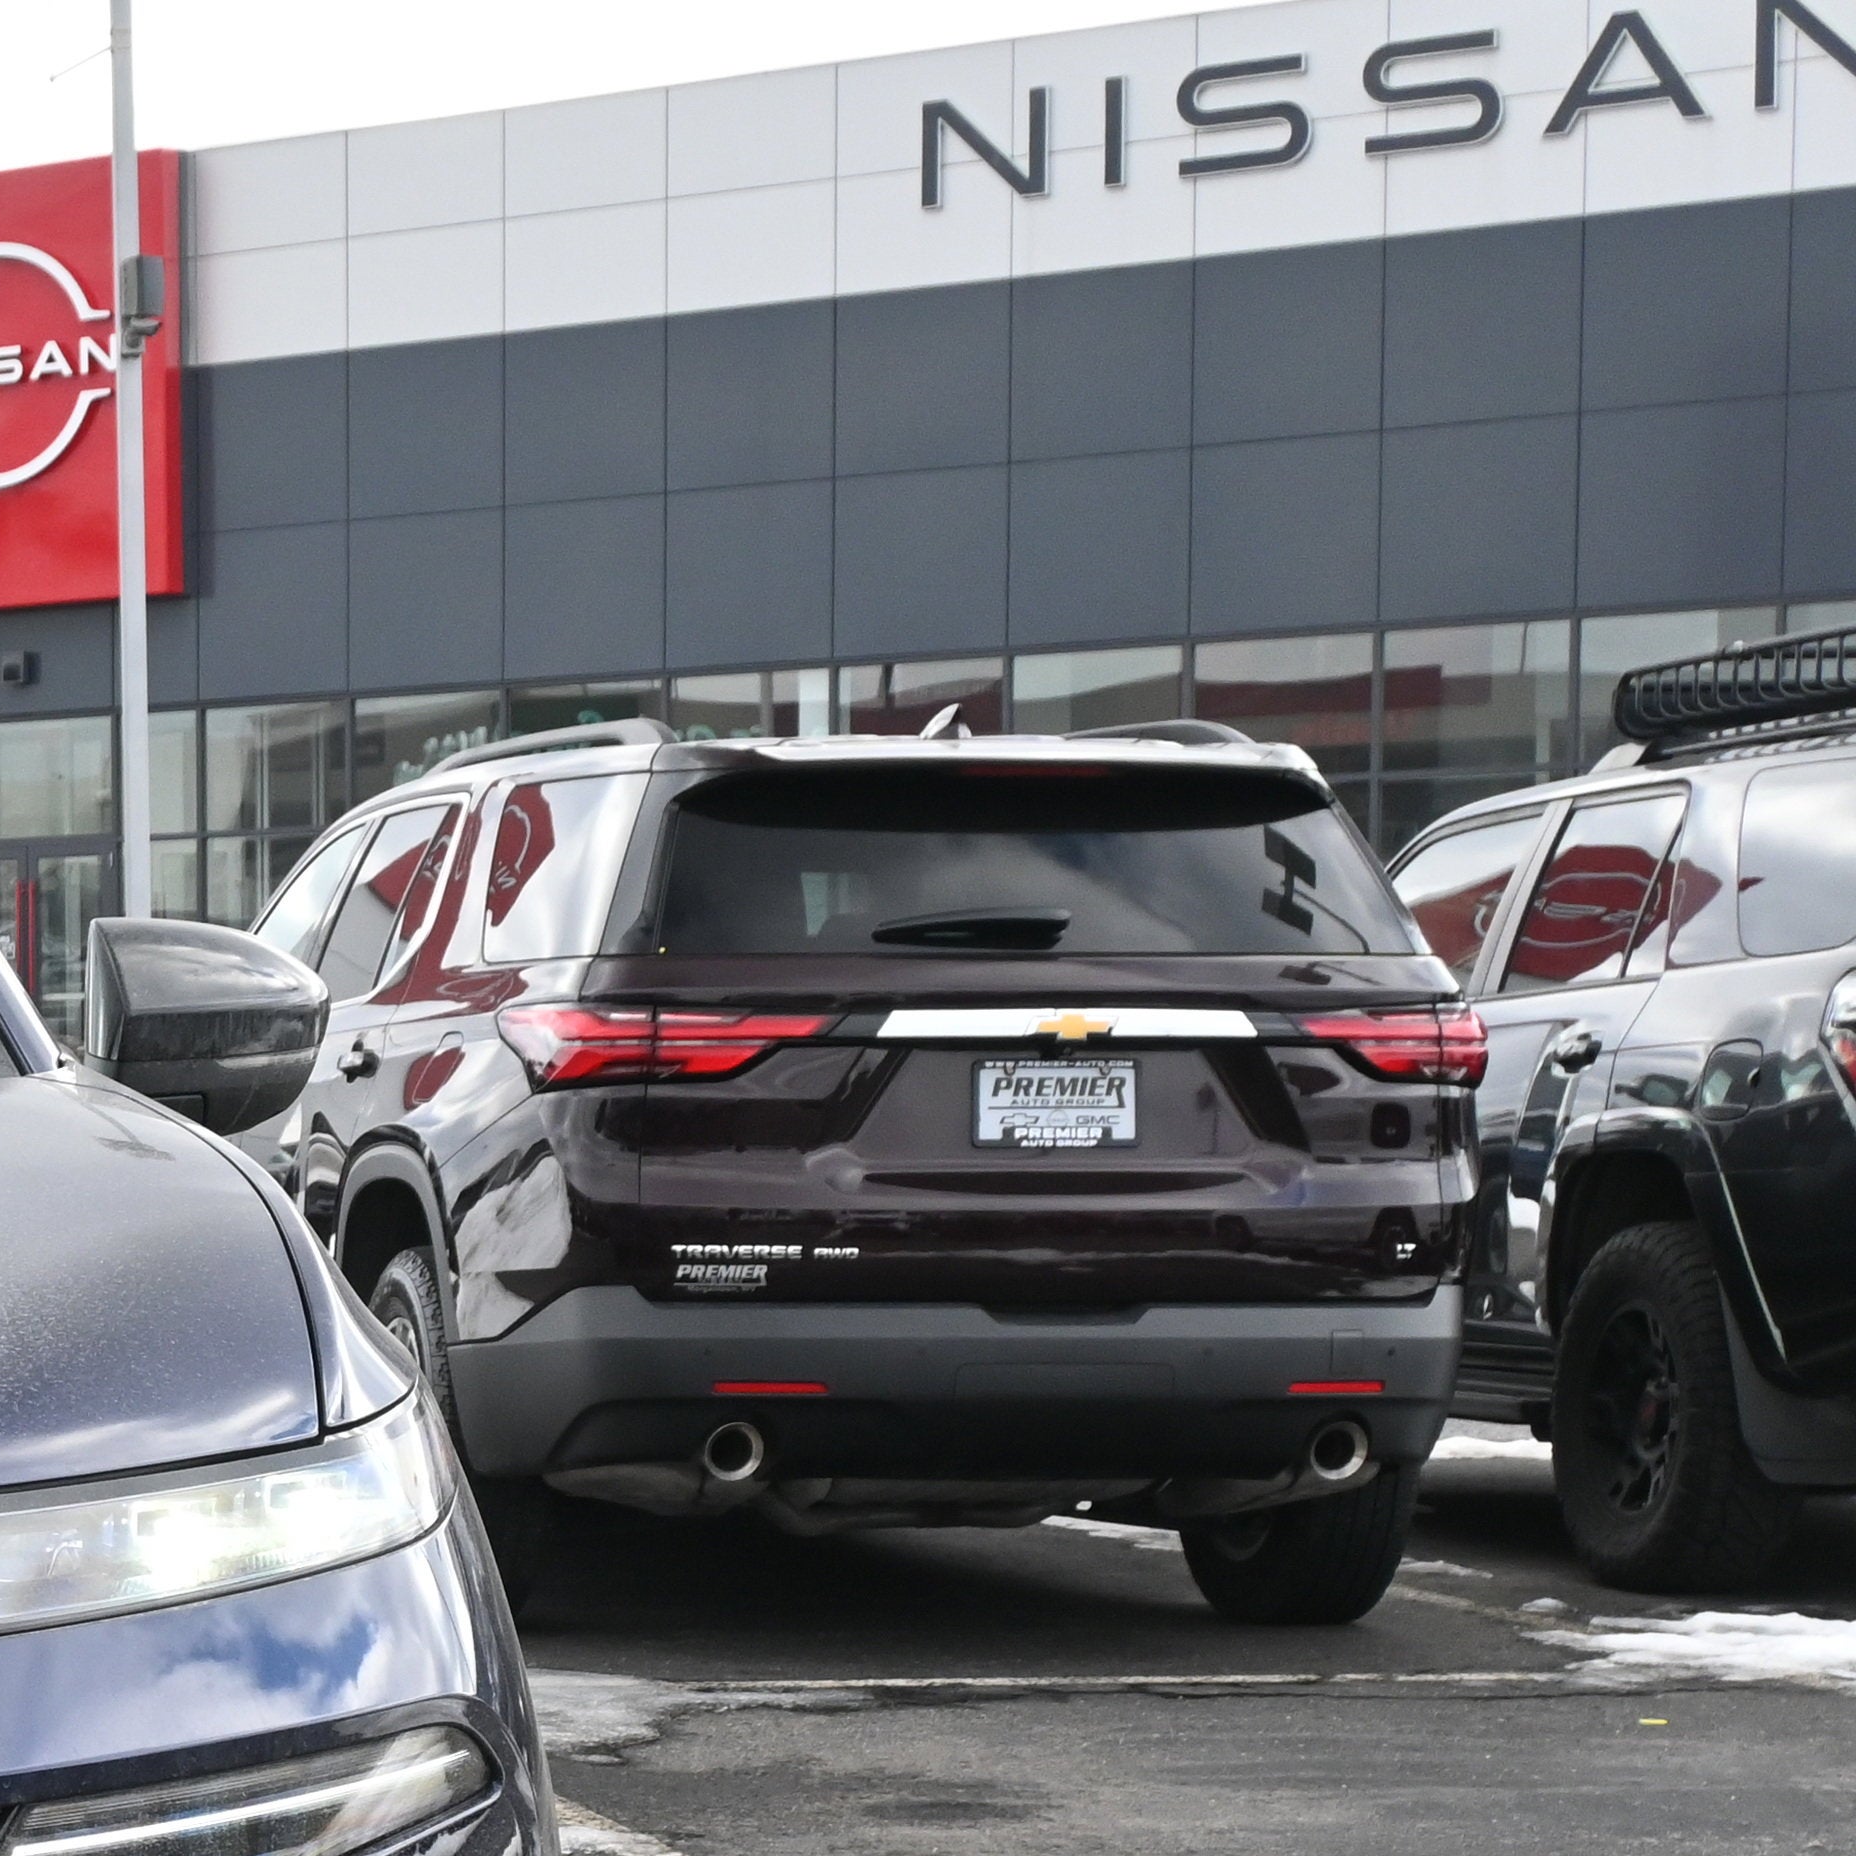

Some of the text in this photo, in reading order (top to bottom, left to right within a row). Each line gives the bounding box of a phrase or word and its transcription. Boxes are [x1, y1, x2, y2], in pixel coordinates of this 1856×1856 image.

[921, 0, 1856, 208] NISSAN
[992, 1077, 1127, 1107] PREMIER
[1076, 1115, 1120, 1124] GMC
[1014, 1127, 1103, 1138] PREMIER
[1021, 1139, 1098, 1147] AUTO GROUP
[671, 1244, 860, 1259] TRAVERSE AWD
[676, 1264, 768, 1285] PREMIER
